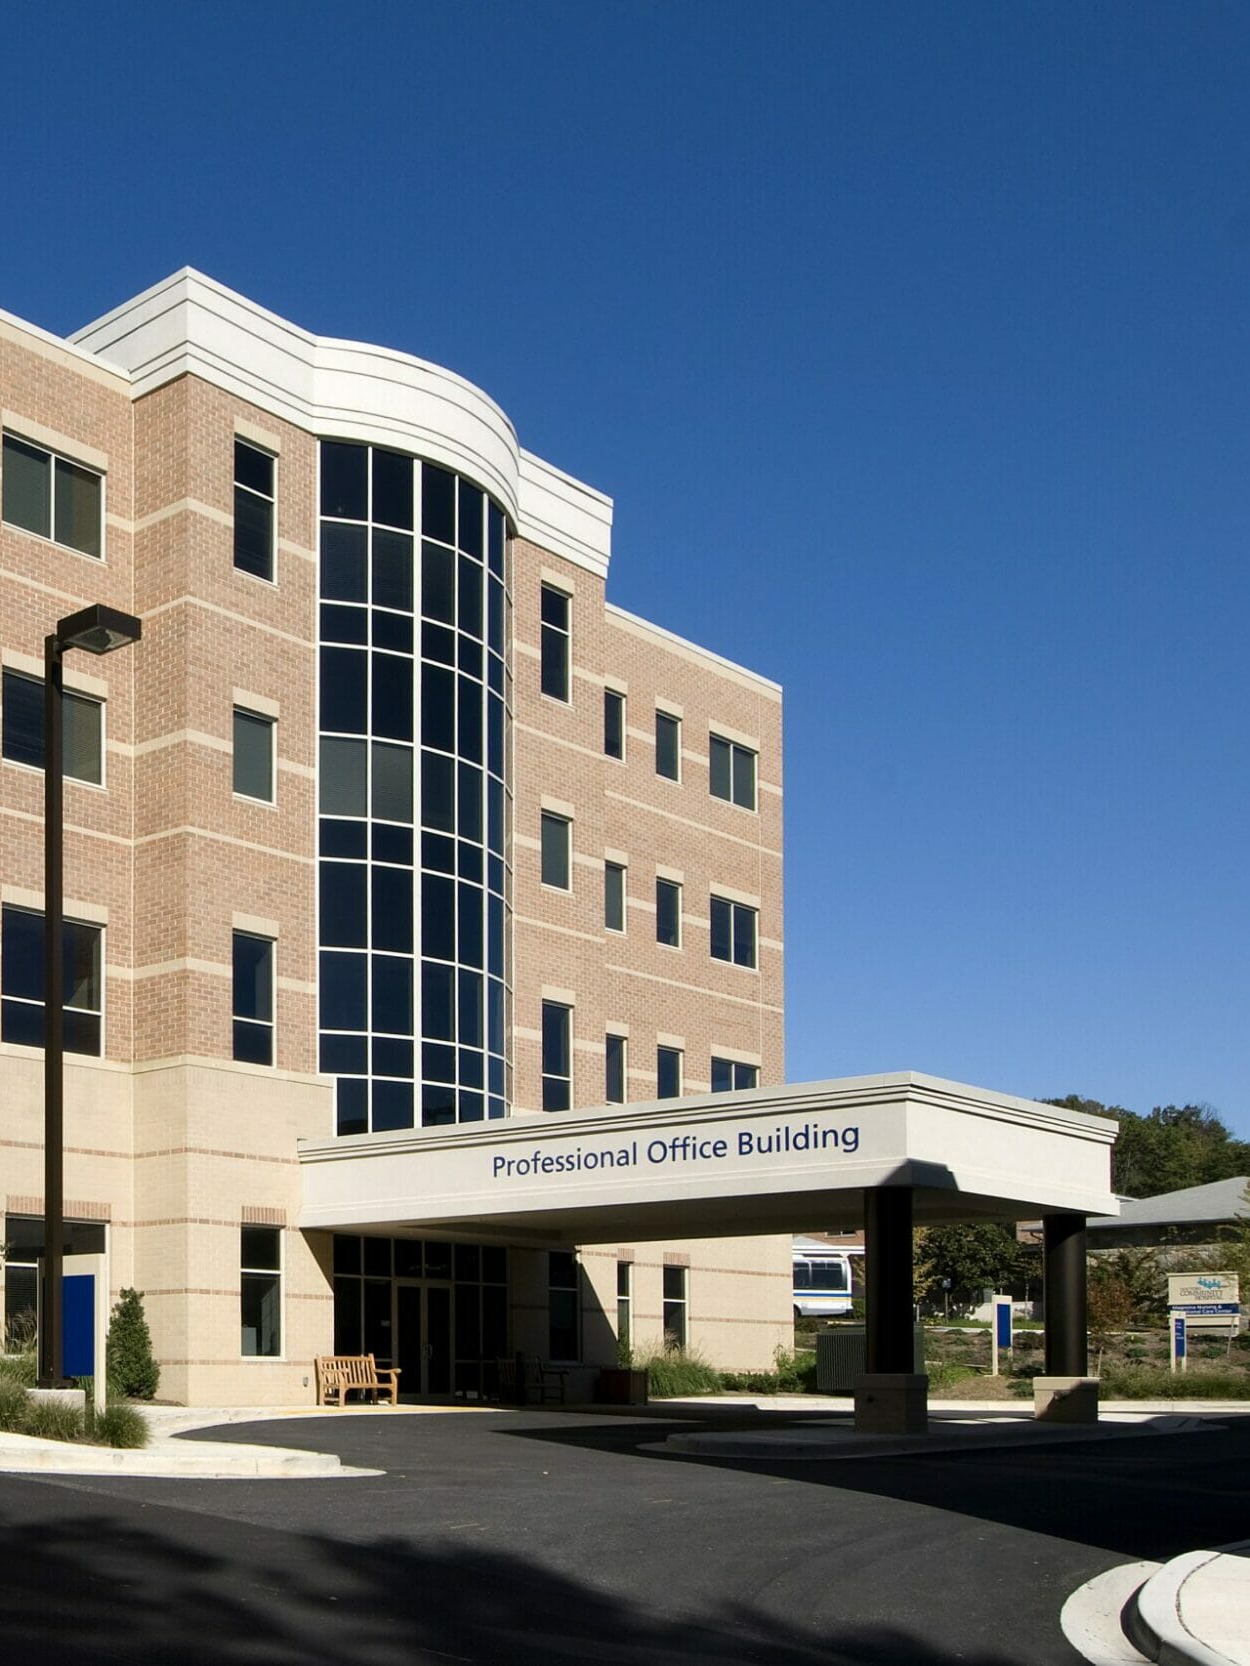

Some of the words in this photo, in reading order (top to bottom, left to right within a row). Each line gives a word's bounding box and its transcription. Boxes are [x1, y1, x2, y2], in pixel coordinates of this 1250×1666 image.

[492, 1141, 638, 1178] Professional
[647, 1136, 728, 1164] Office
[737, 1123, 860, 1156] Building
